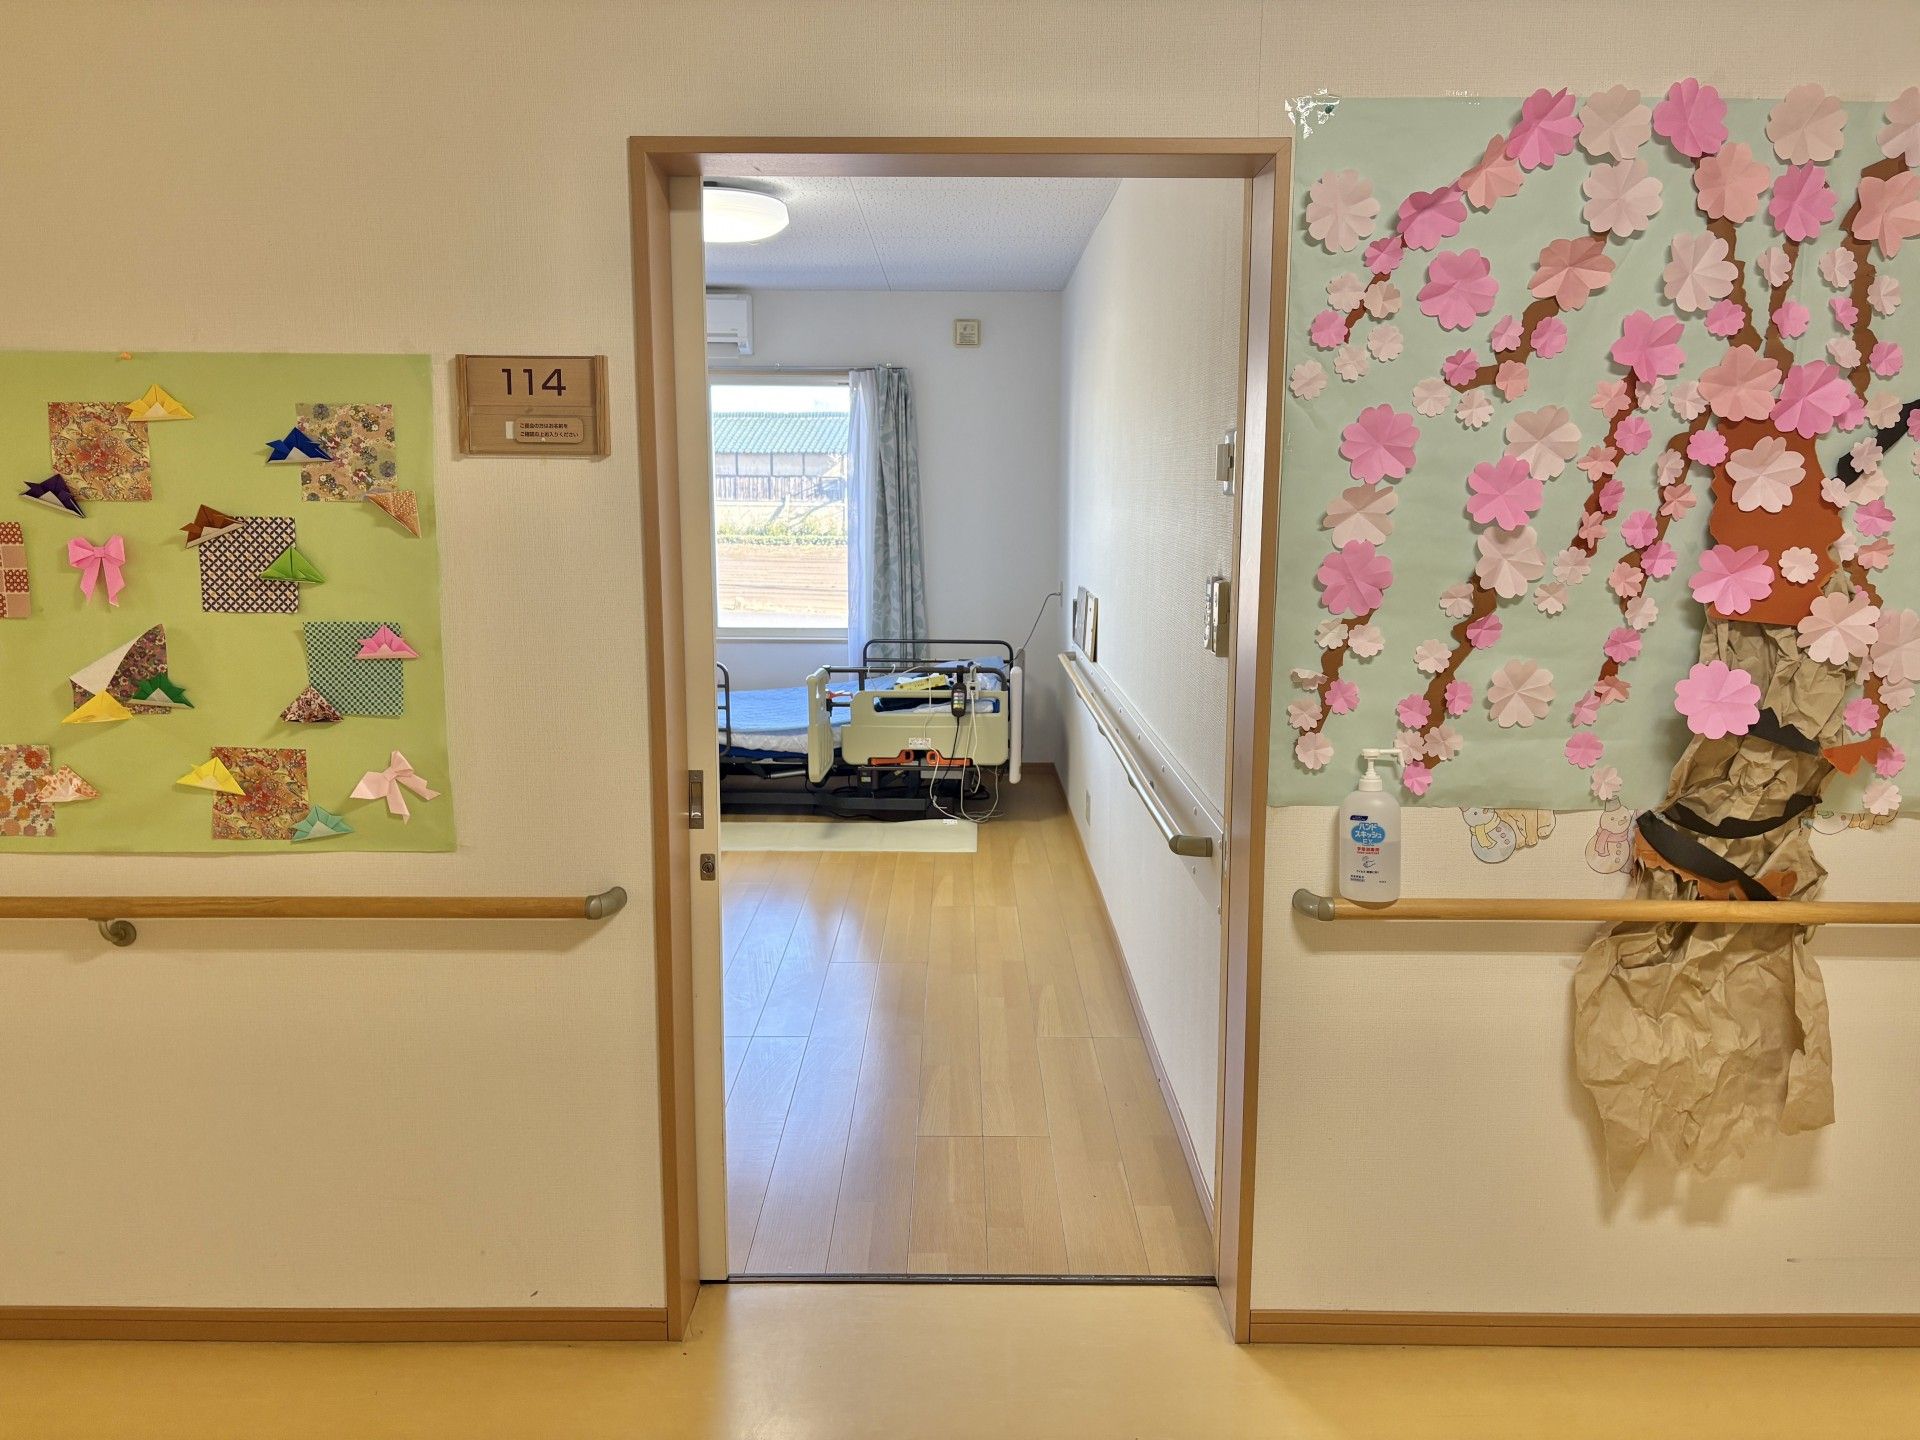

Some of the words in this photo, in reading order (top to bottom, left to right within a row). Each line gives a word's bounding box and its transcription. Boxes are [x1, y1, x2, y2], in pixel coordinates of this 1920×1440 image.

[501, 368, 567, 396] 114
[1359, 822, 1378, 831] ハンド
[1355, 830, 1382, 838] スキッシュ
